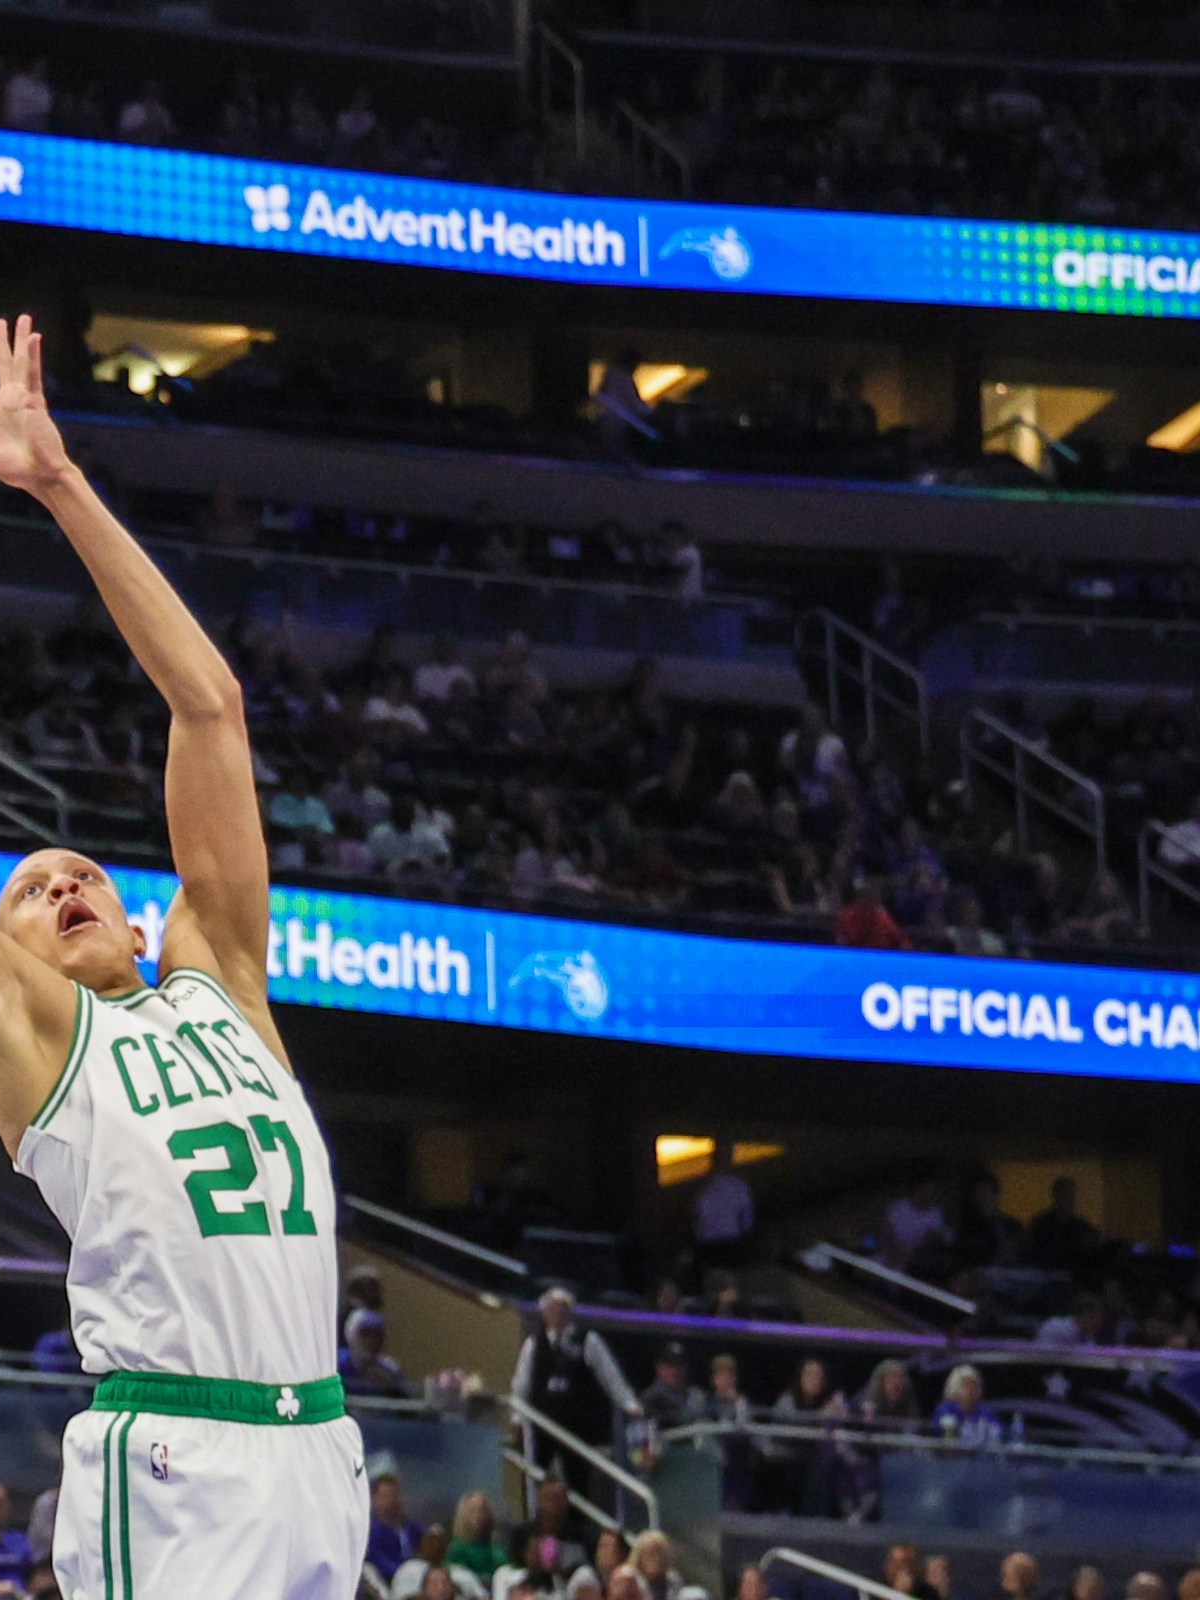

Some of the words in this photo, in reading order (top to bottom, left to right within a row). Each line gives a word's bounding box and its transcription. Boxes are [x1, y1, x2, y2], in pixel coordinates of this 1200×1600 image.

[300, 189, 626, 267] AdventHealth
[861, 981, 1083, 1043] OFFICIAL
[1093, 998, 1200, 1051] CHA
[166, 1113, 318, 1238] 27
